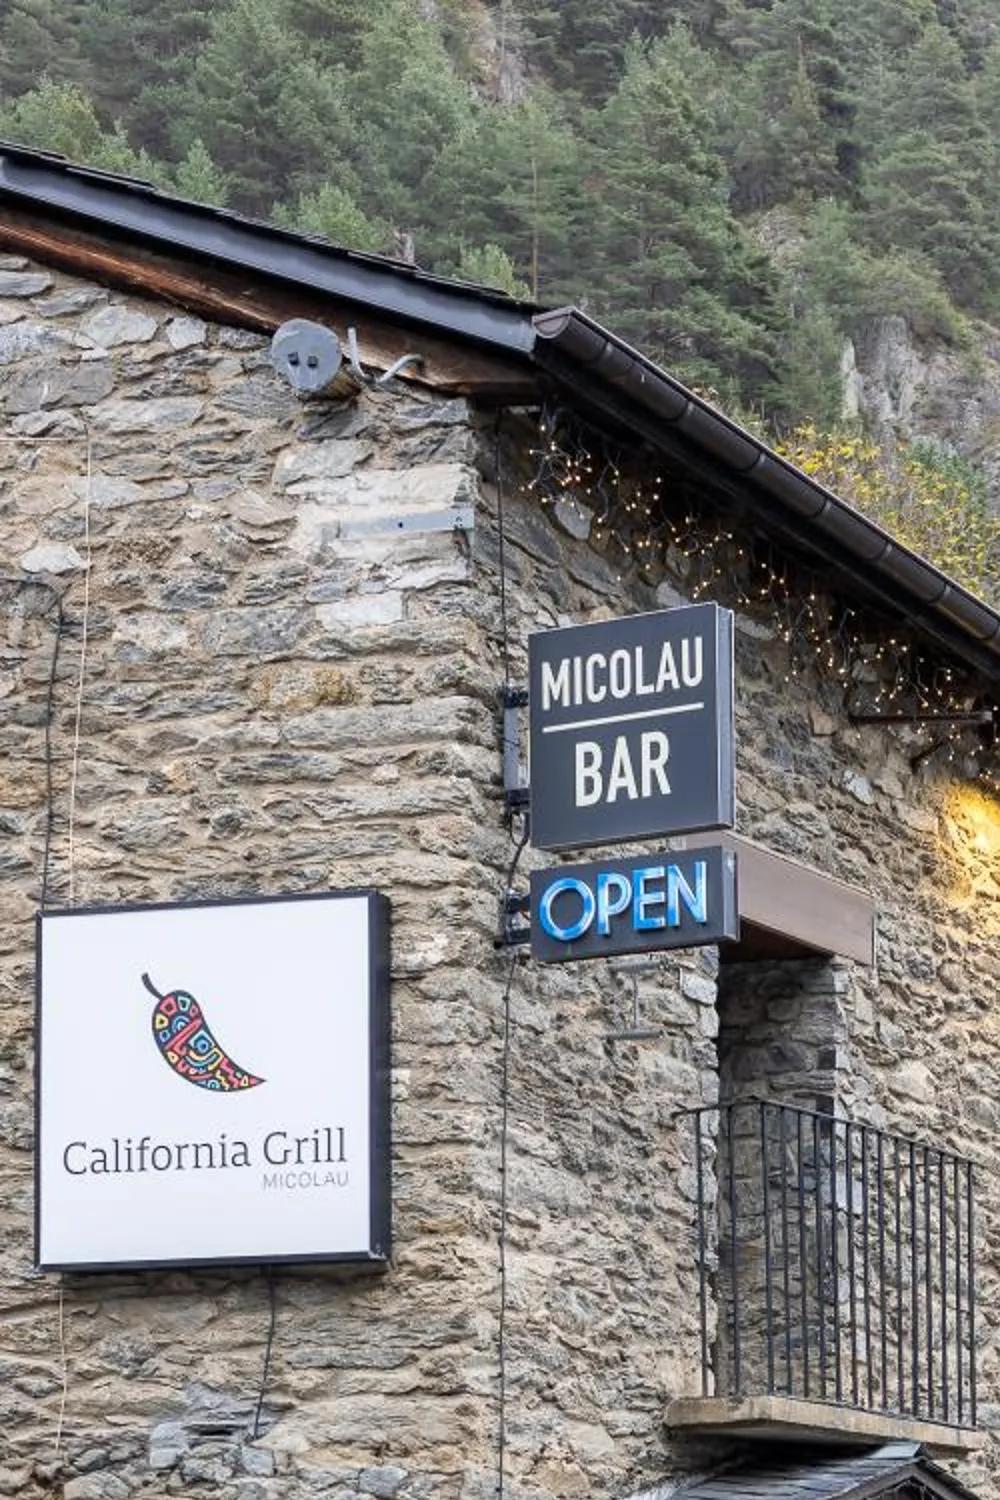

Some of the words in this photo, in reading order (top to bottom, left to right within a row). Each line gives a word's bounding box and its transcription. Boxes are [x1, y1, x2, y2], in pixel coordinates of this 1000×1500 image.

[541, 636, 704, 710] MICOLAU
[575, 731, 671, 807] BAR
[539, 861, 707, 941] OPEN
[63, 1133, 252, 1175] California
[263, 1127, 348, 1165] Grill
[262, 1171, 349, 1189] MICOLAU
